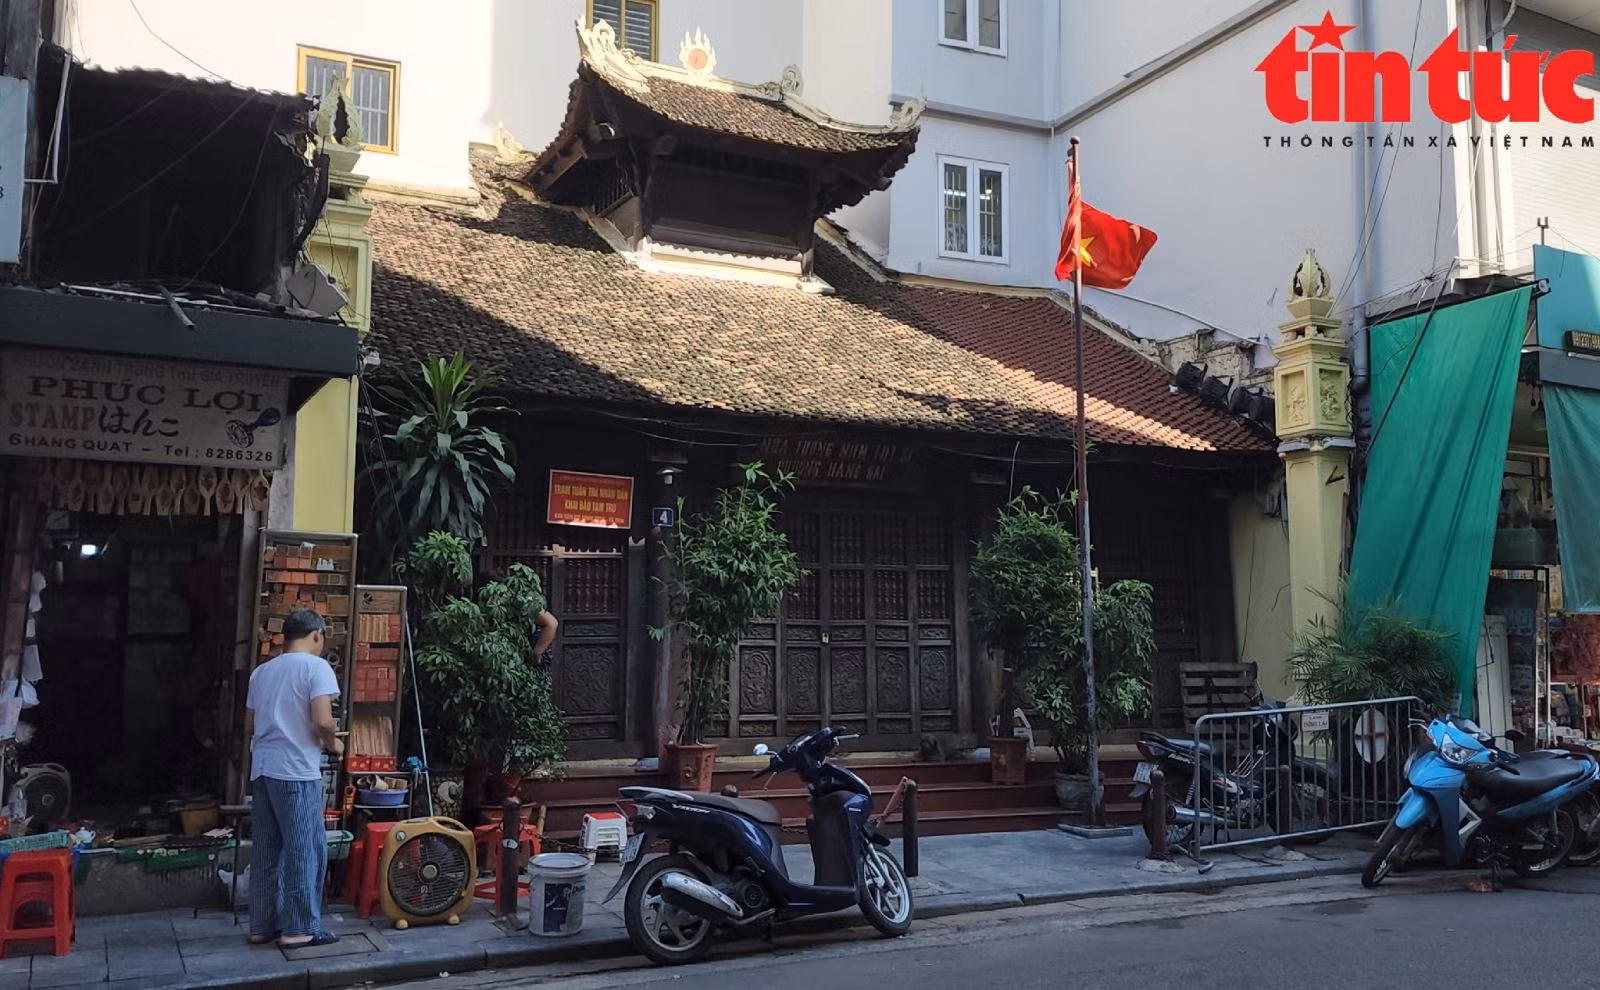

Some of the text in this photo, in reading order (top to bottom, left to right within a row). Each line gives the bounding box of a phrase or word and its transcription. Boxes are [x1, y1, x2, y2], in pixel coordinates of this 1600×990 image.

[27, 375, 264, 415] PHÚC LỢI
[9, 402, 179, 437] STAMP はんこ
[206, 447, 273, 462] 8286326
[660, 510, 669, 523] 4
